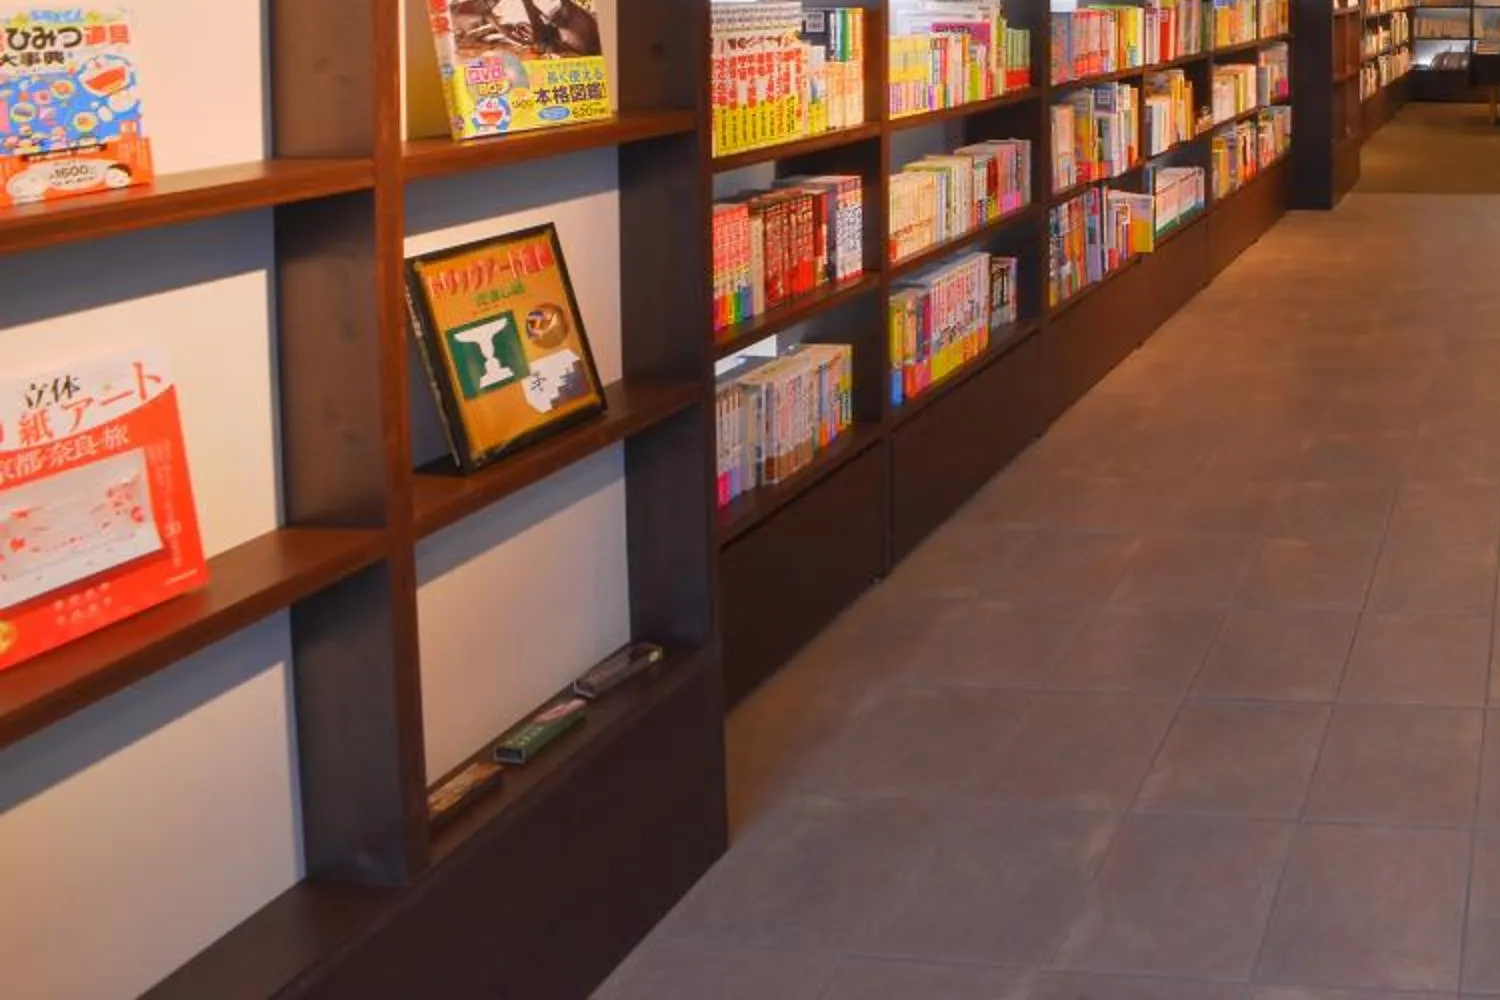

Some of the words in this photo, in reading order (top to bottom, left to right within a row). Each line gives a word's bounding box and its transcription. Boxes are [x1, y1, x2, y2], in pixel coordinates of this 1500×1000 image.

[0, 23, 130, 51] ひみつ道具
[0, 361, 163, 447] 紙アート
[24, 374, 81, 409] 立体
